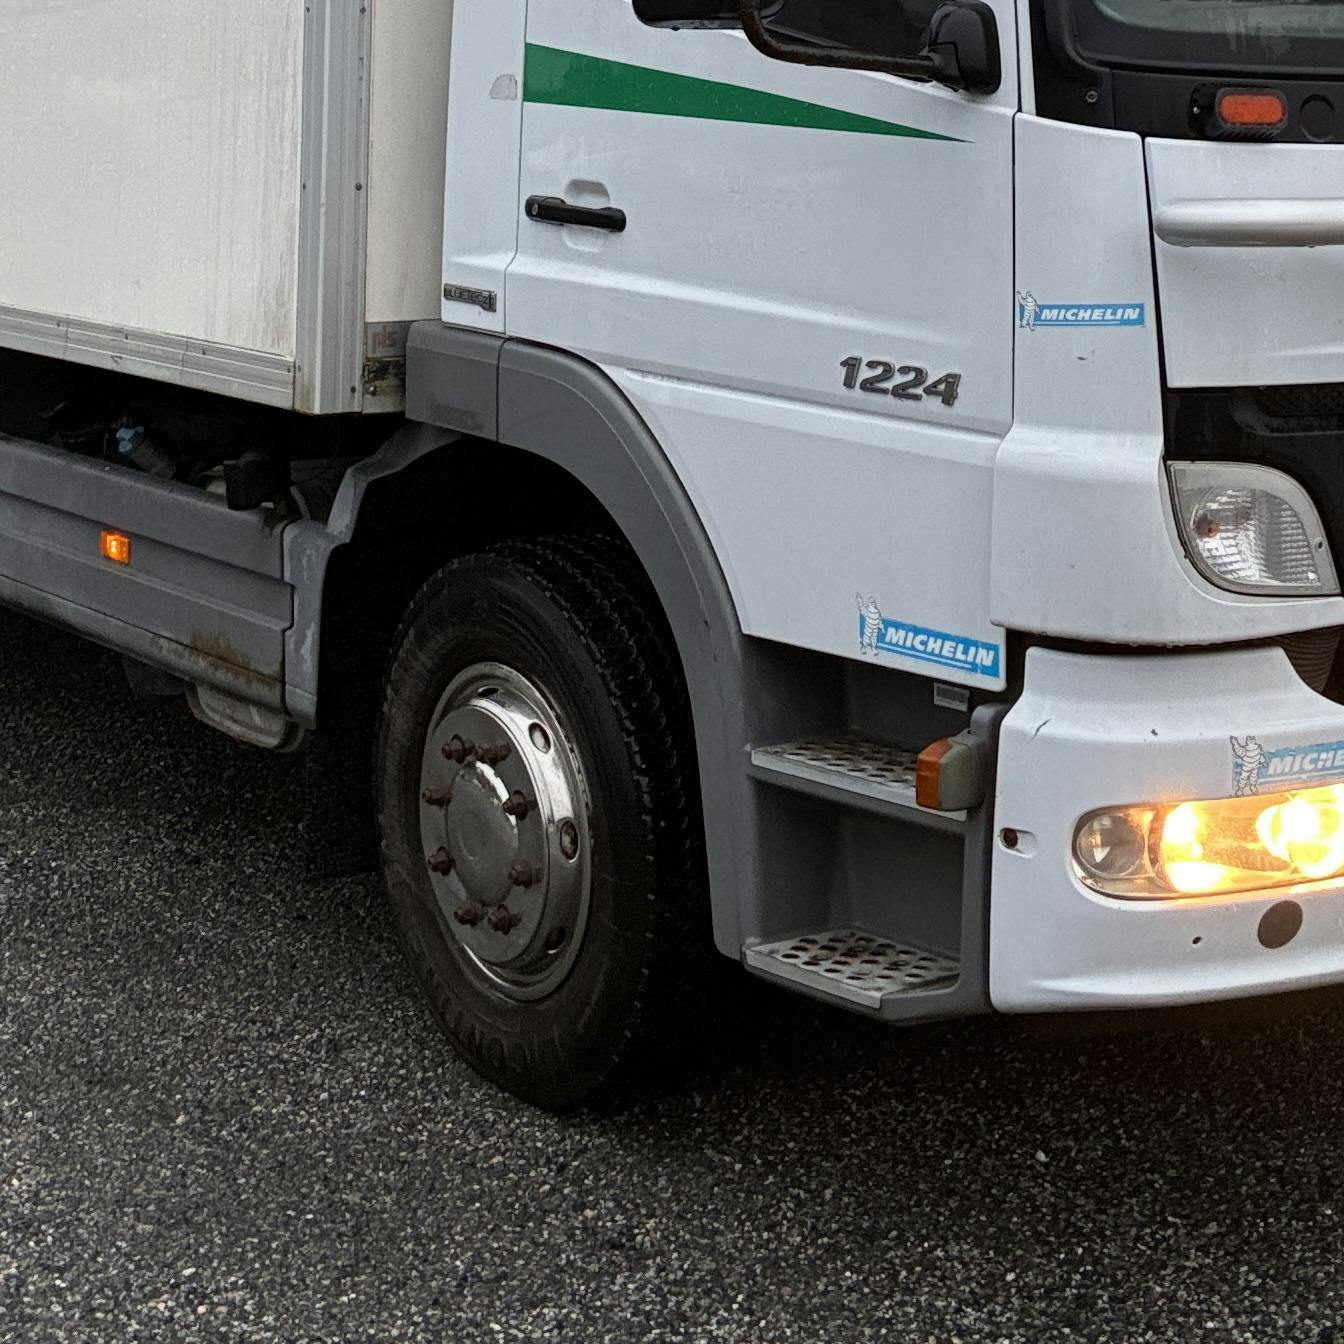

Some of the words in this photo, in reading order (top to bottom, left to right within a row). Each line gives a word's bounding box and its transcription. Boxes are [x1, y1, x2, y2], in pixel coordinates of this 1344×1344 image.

[1039, 307, 1141, 321] MICHELIN
[839, 355, 962, 407] 1224
[884, 626, 996, 668] MICHELIN
